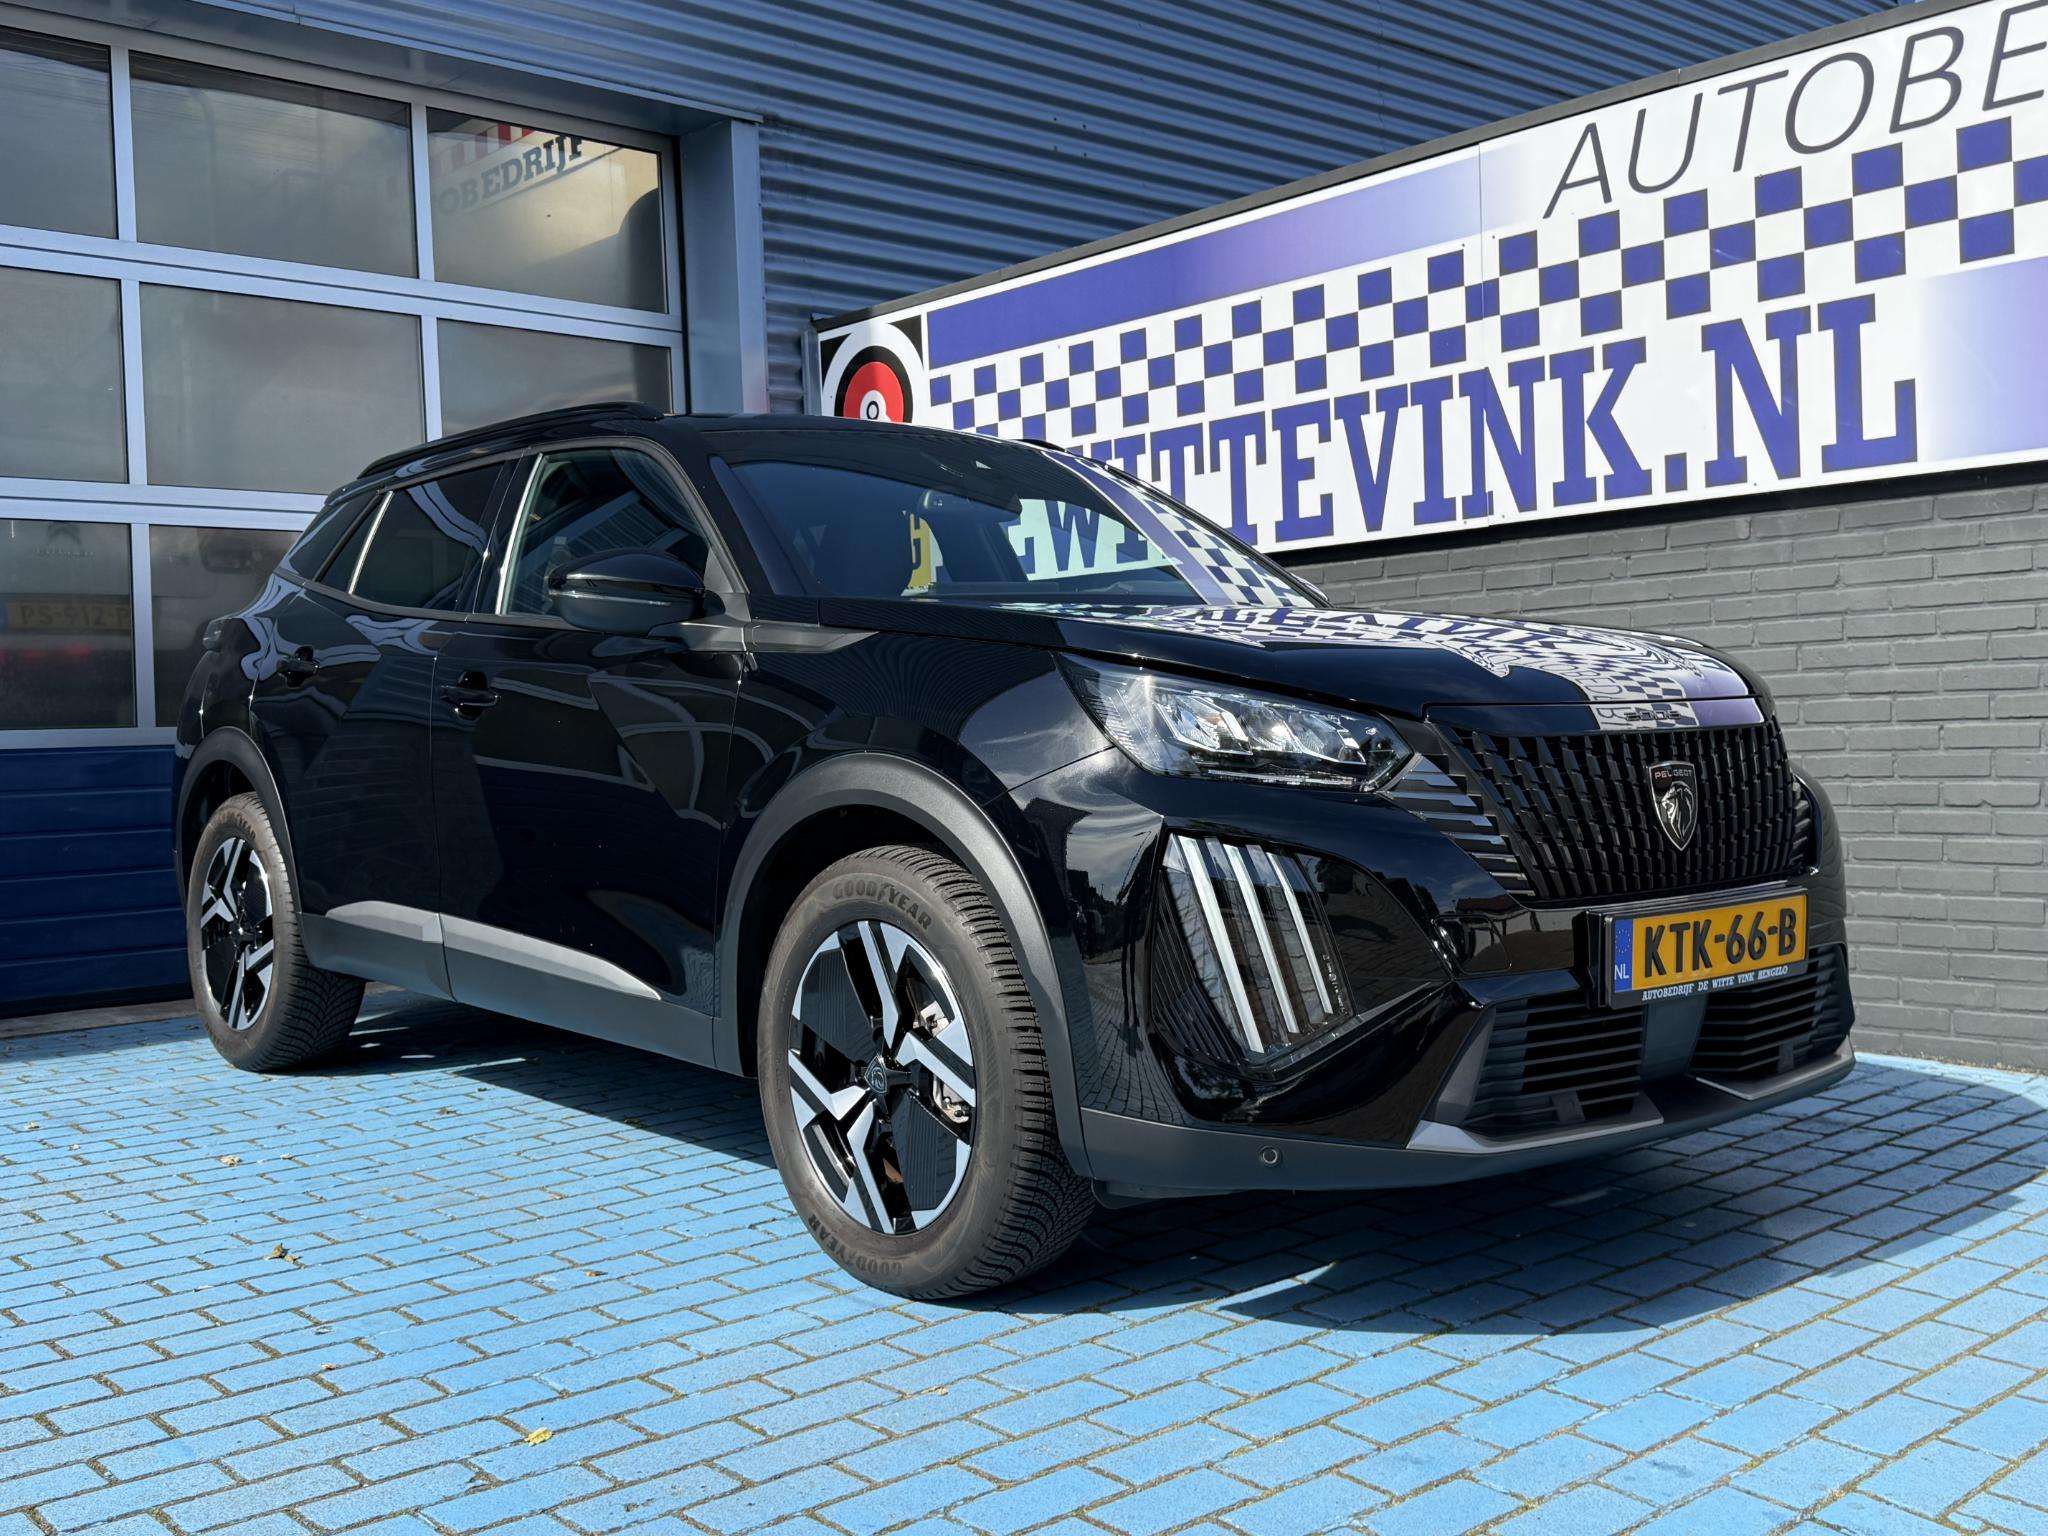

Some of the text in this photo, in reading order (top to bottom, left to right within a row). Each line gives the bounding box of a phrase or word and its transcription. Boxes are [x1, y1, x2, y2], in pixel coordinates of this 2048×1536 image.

[1654, 768, 1693, 779] PEUGEOT
[832, 879, 932, 930] GOODYEAR
[1644, 907, 1797, 978] KTK-66-B
[1614, 963, 1630, 980] NL
[1642, 983, 1694, 1001] AUTOBEDRIJF
[1698, 980, 1708, 991] DE
[1712, 977, 1734, 990] WITTE
[1738, 972, 1755, 985] VINK
